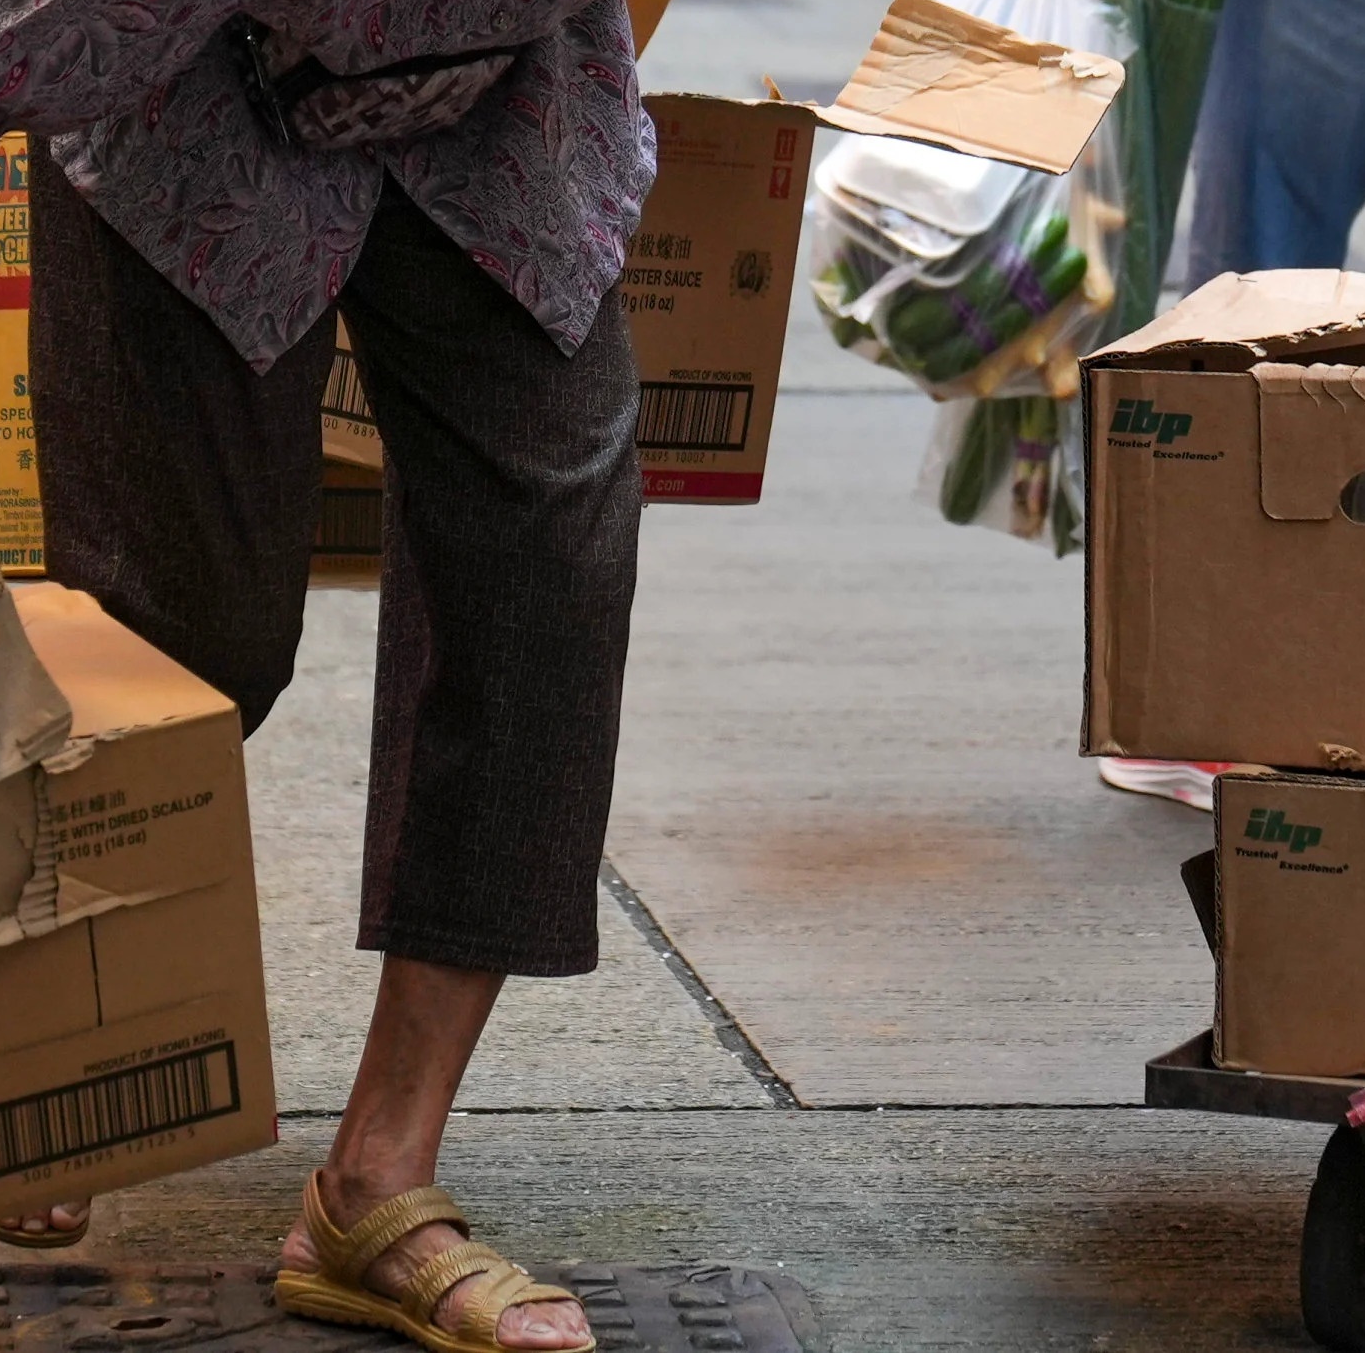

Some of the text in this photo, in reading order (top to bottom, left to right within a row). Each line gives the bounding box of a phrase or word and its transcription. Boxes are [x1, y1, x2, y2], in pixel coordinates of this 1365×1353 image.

[4, 235, 29, 264] CH
[664, 270, 703, 288] SAUCE
[630, 296, 637, 313] g
[639, 294, 656, 313] (18
[658, 295, 675, 314] oz)
[669, 369, 752, 381] PRODUCT OF HONG KONG
[0, 408, 34, 420] SPEC
[1109, 398, 1193, 444] ibp
[17, 427, 35, 440] HO
[346, 421, 382, 440] 7889
[1107, 438, 1152, 448] Trusted
[643, 475, 685, 492] K.com
[71, 821, 105, 840] WITH
[108, 810, 149, 830] DRIED
[151, 791, 214, 819] SCALLOP
[1244, 808, 1322, 853] ibp
[94, 842, 102, 857] g
[1235, 847, 1278, 860] Trusted
[84, 1028, 226, 1076] PRODUCT OF HONG KONG
